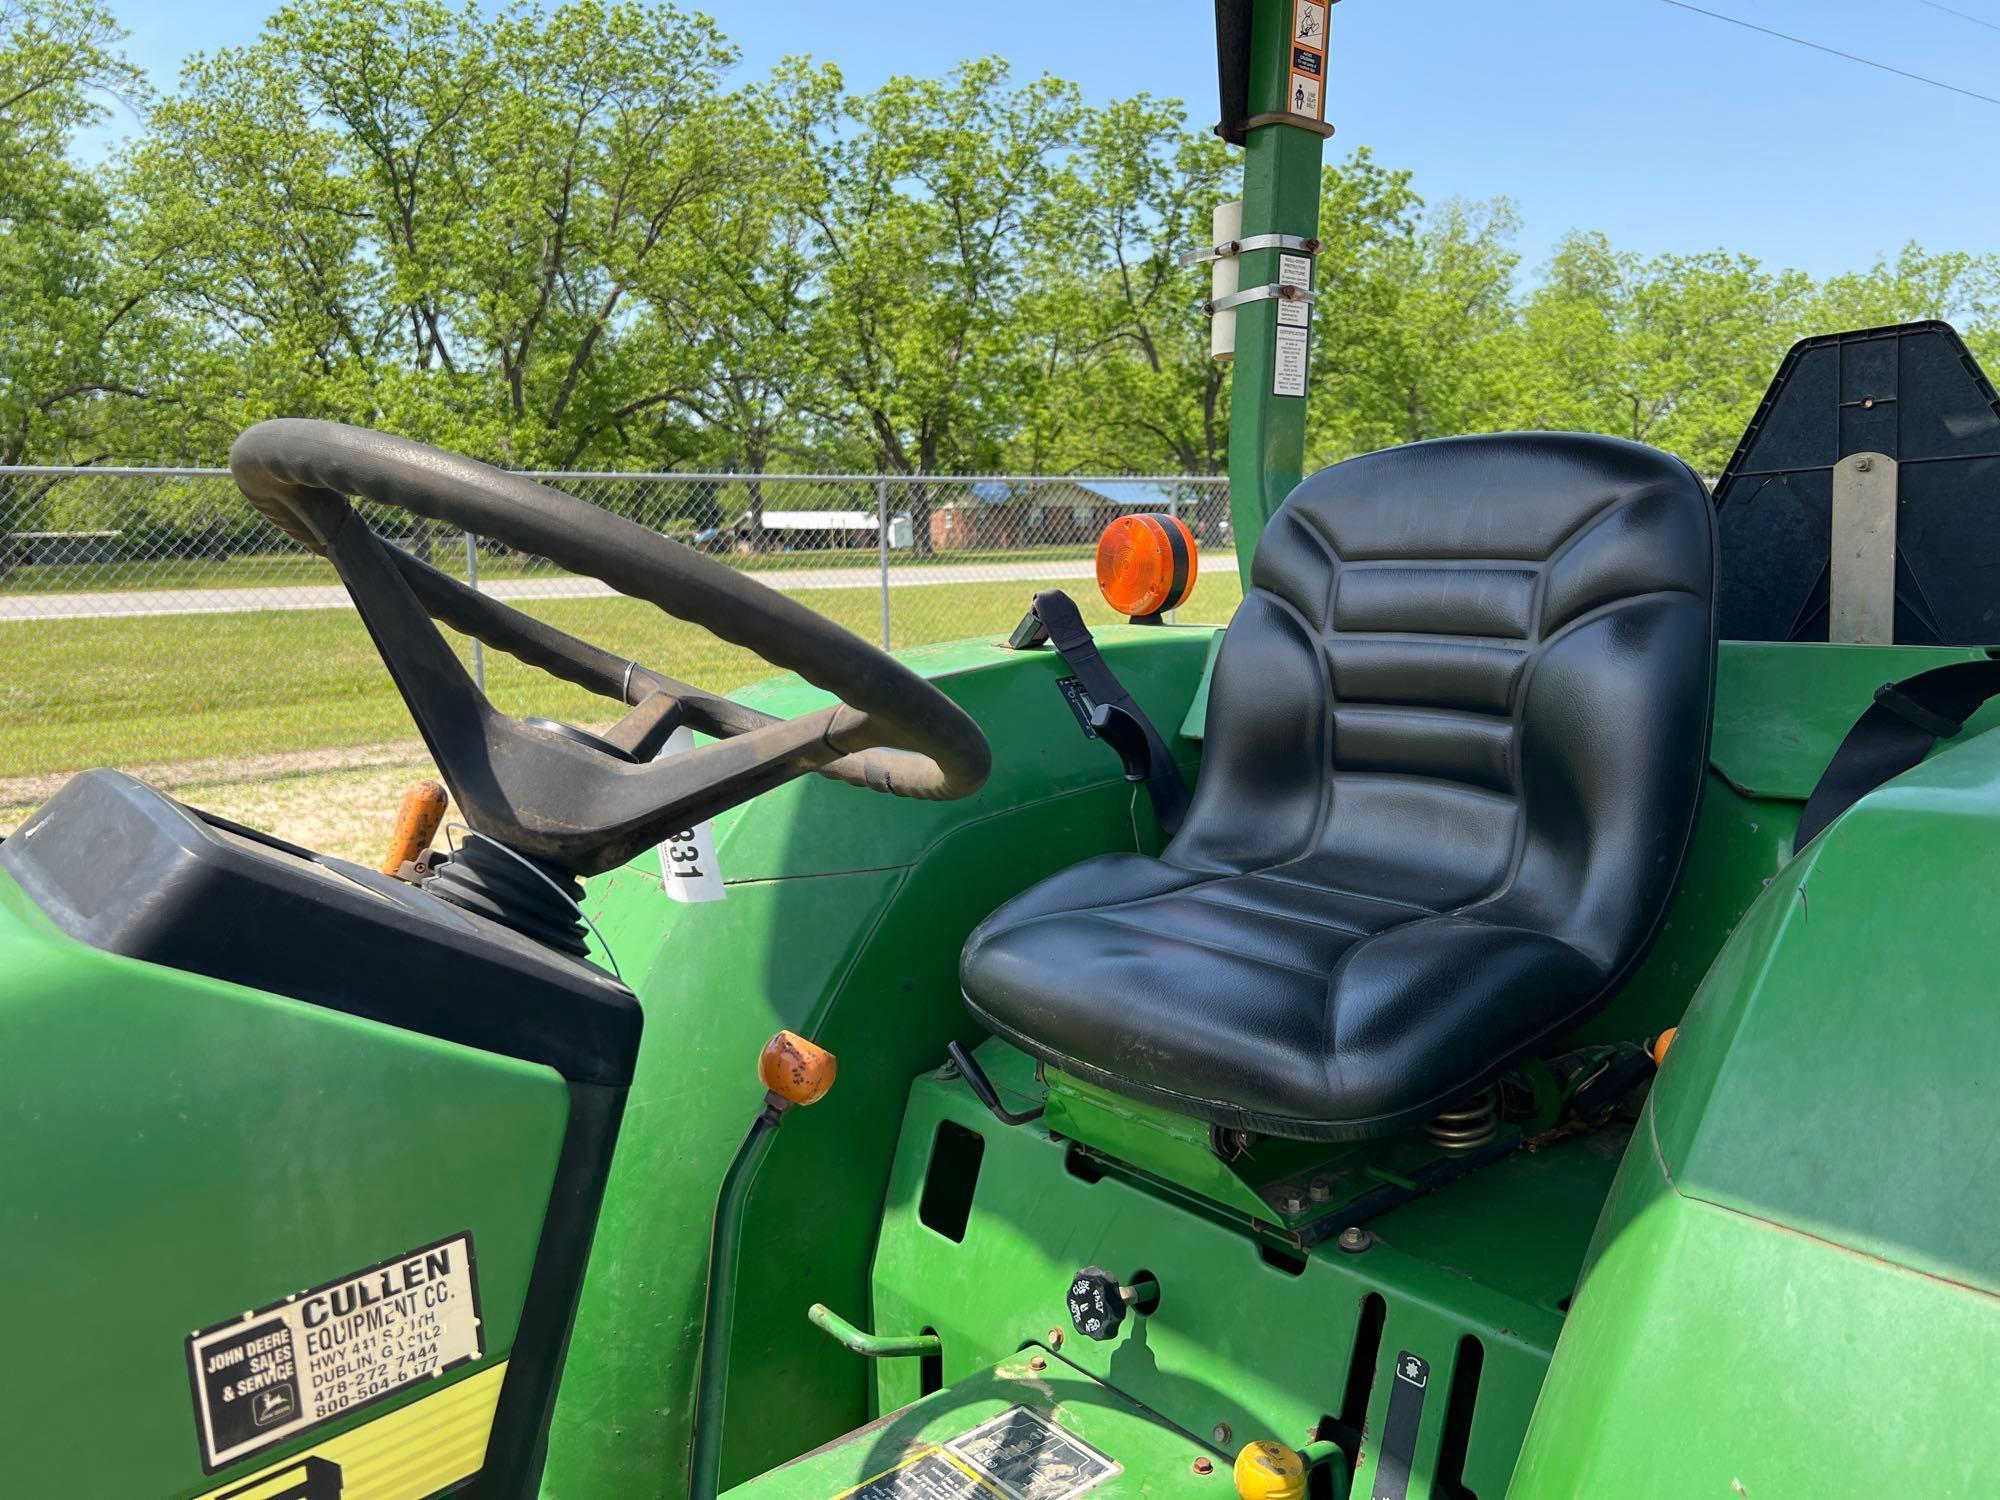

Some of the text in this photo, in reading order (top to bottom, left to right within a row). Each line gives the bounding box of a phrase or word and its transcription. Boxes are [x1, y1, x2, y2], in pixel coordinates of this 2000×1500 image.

[302, 1249, 451, 1329] CULLEN
[306, 1291, 418, 1356] EQUIPMENT
[207, 1328, 290, 1374] JOHN DEERE
[250, 1345, 292, 1373] SALES
[310, 1347, 347, 1373] HWY
[312, 1353, 378, 1388] DUBLIN,
[314, 1342, 438, 1403] 478-2727444
[222, 1361, 295, 1403] & SERVICE
